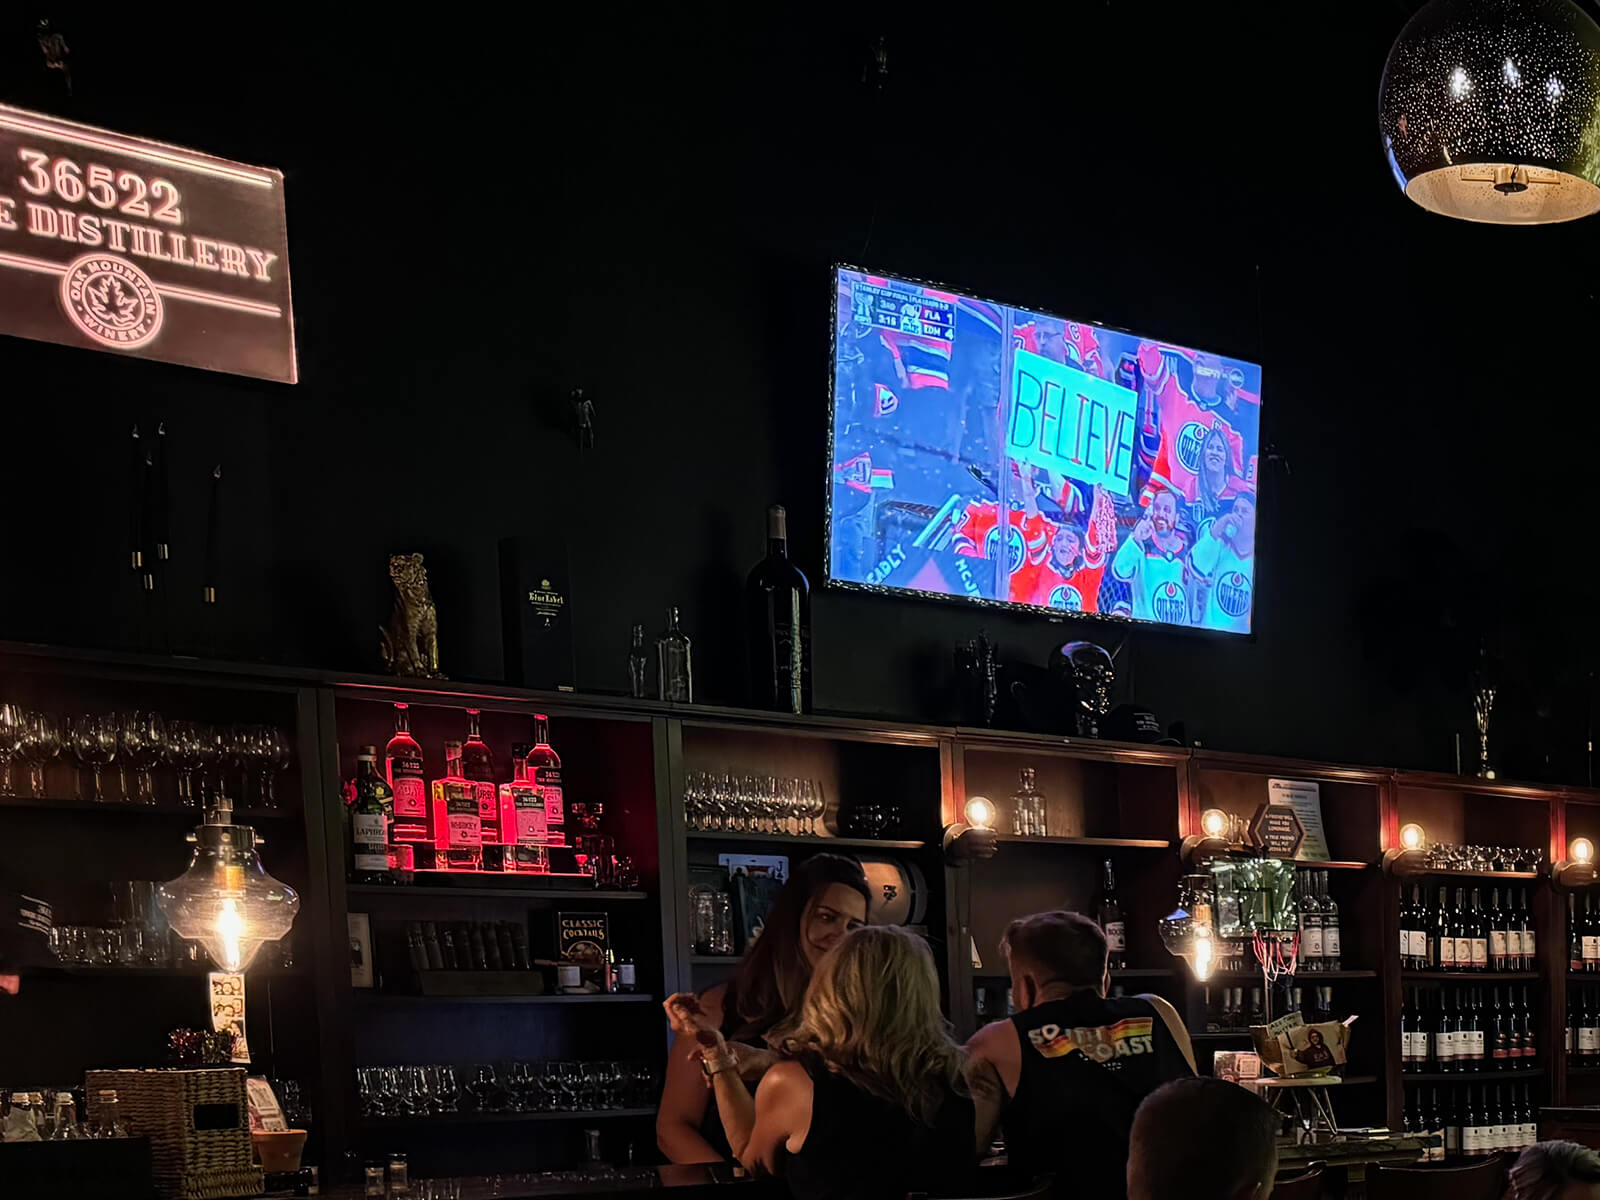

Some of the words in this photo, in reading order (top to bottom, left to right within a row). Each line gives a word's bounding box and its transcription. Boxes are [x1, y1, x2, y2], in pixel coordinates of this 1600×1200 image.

[19, 148, 182, 225] 36522
[27, 202, 278, 282] DISTILLERY
[71, 270, 88, 300] OAK
[87, 261, 156, 315] MOUNTAIN
[83, 313, 147, 340] WINERY
[924, 309, 940, 321] FLA
[946, 313, 953, 325] 1
[924, 324, 941, 336] EDM
[944, 329, 954, 340] 4
[1011, 369, 1135, 481] BELIEVE
[561, 920, 604, 928] CLASSIC
[562, 928, 605, 940] COCKTAILS
